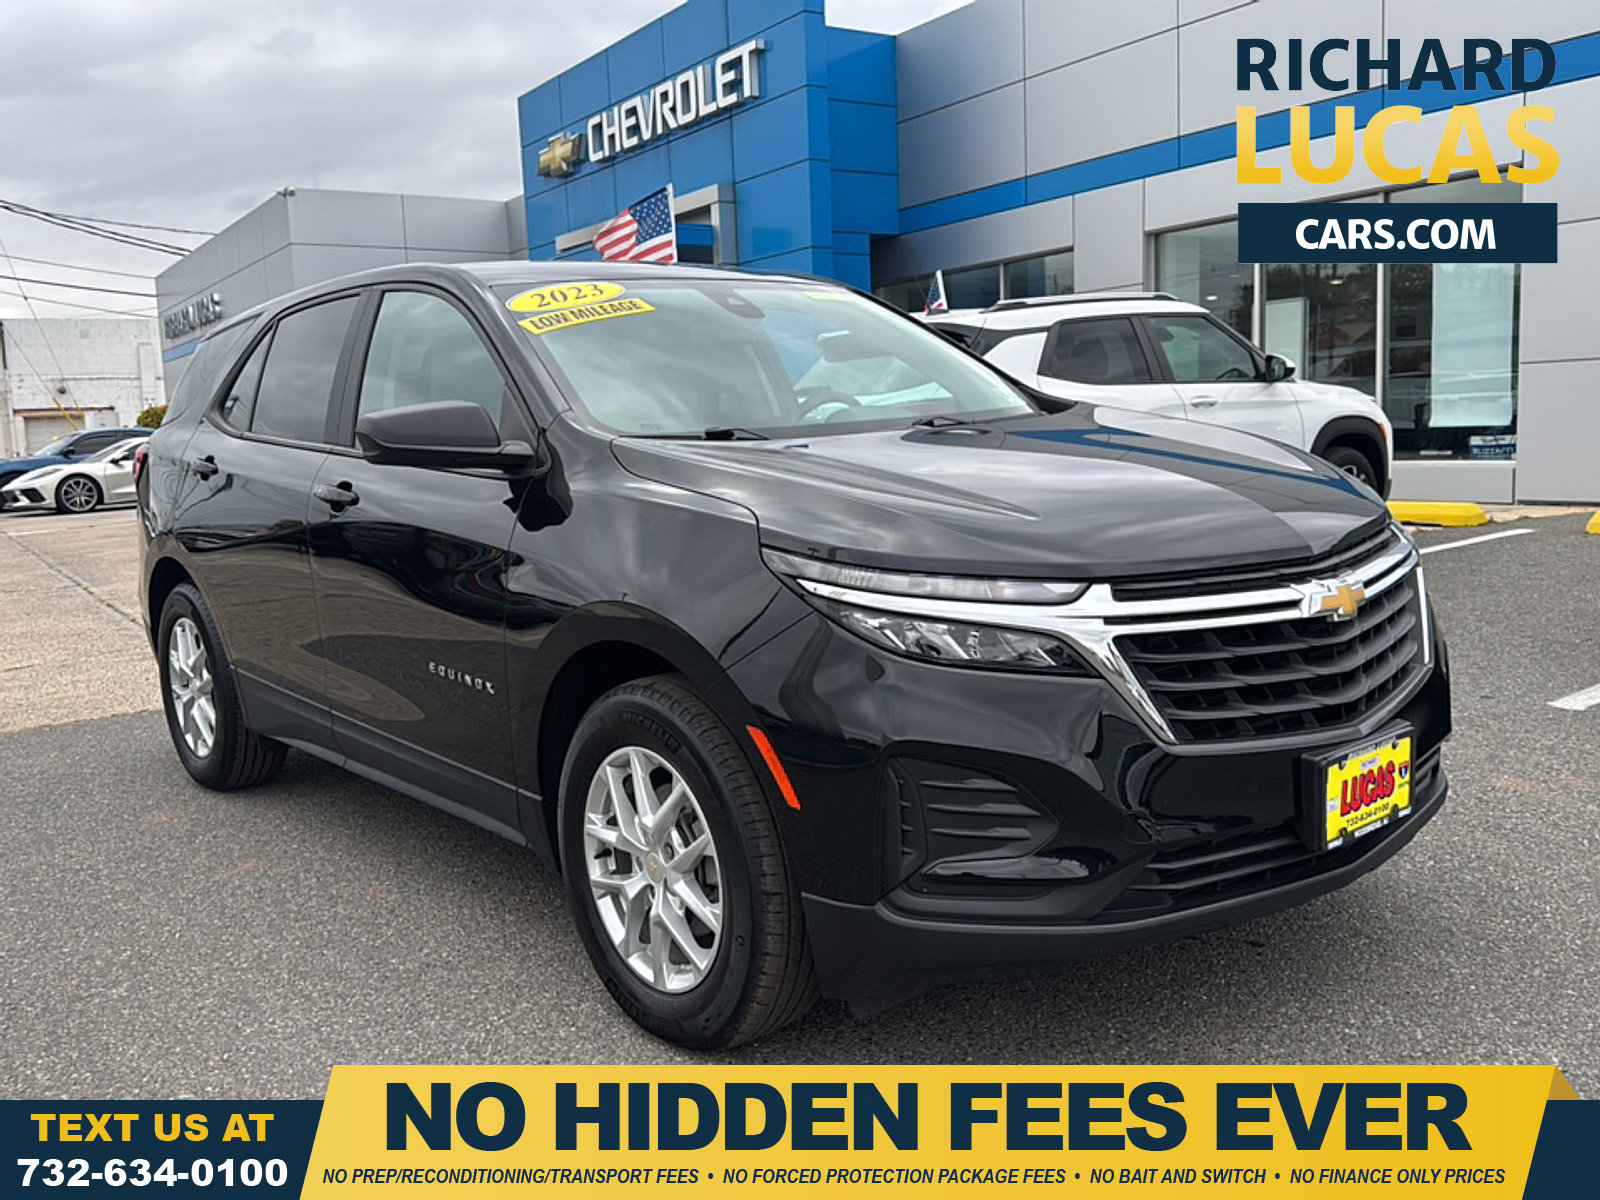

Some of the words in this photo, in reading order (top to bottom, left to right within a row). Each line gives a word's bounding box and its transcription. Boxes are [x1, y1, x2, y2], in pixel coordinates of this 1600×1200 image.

[587, 40, 764, 162] CHEVROLET
[530, 283, 604, 308] 2023
[529, 311, 571, 331] LOW
[571, 299, 644, 321] MILEAGE
[428, 661, 495, 695] EQUINOX
[1340, 760, 1396, 817] LUCAS
